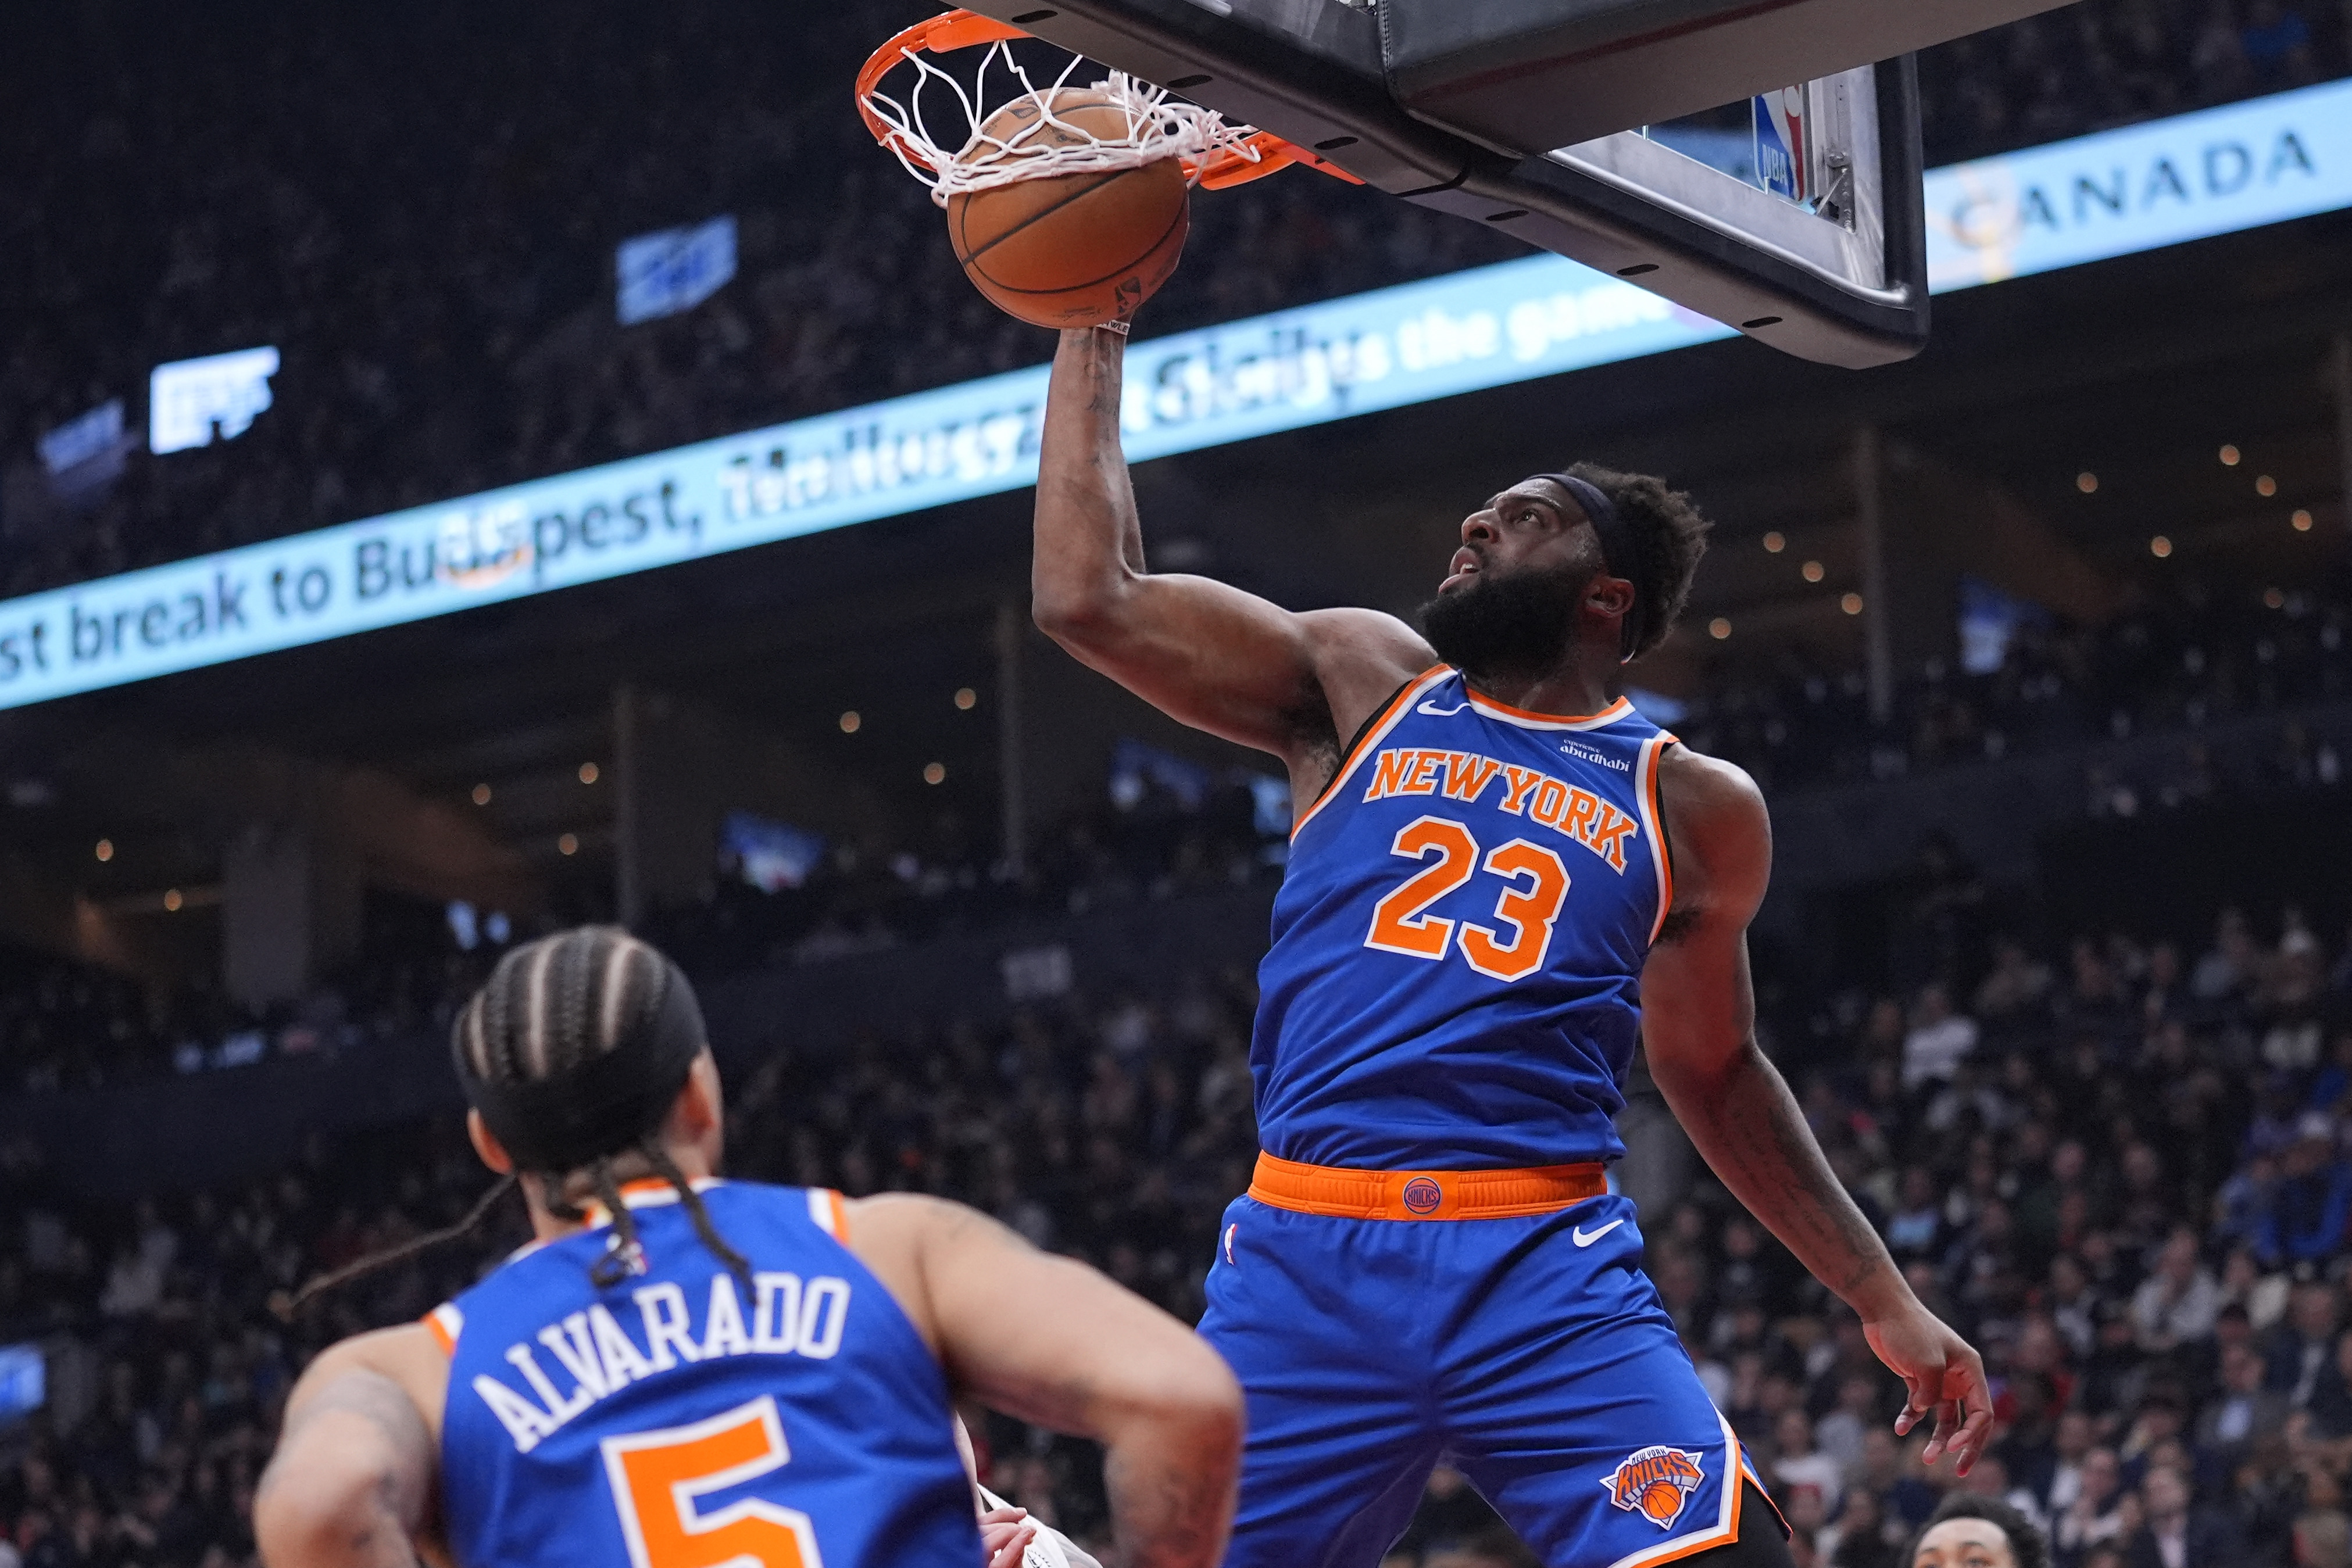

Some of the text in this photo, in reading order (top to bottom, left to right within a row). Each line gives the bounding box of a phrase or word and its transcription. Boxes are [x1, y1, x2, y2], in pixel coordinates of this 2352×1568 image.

[1762, 143, 1789, 187] NBA
[70, 571, 249, 661] break
[273, 566, 332, 617] to
[1560, 745, 1631, 772] abu dhabi
[1363, 747, 1639, 877] NEW YORK
[1363, 814, 1571, 983] 23
[1408, 1188, 1436, 1205] KNICKS
[471, 1270, 852, 1454] ALVARADO
[600, 1393, 824, 1568] 5
[1615, 1451, 1701, 1503] KNICKS
[1631, 1448, 1667, 1465] NEW YORK
